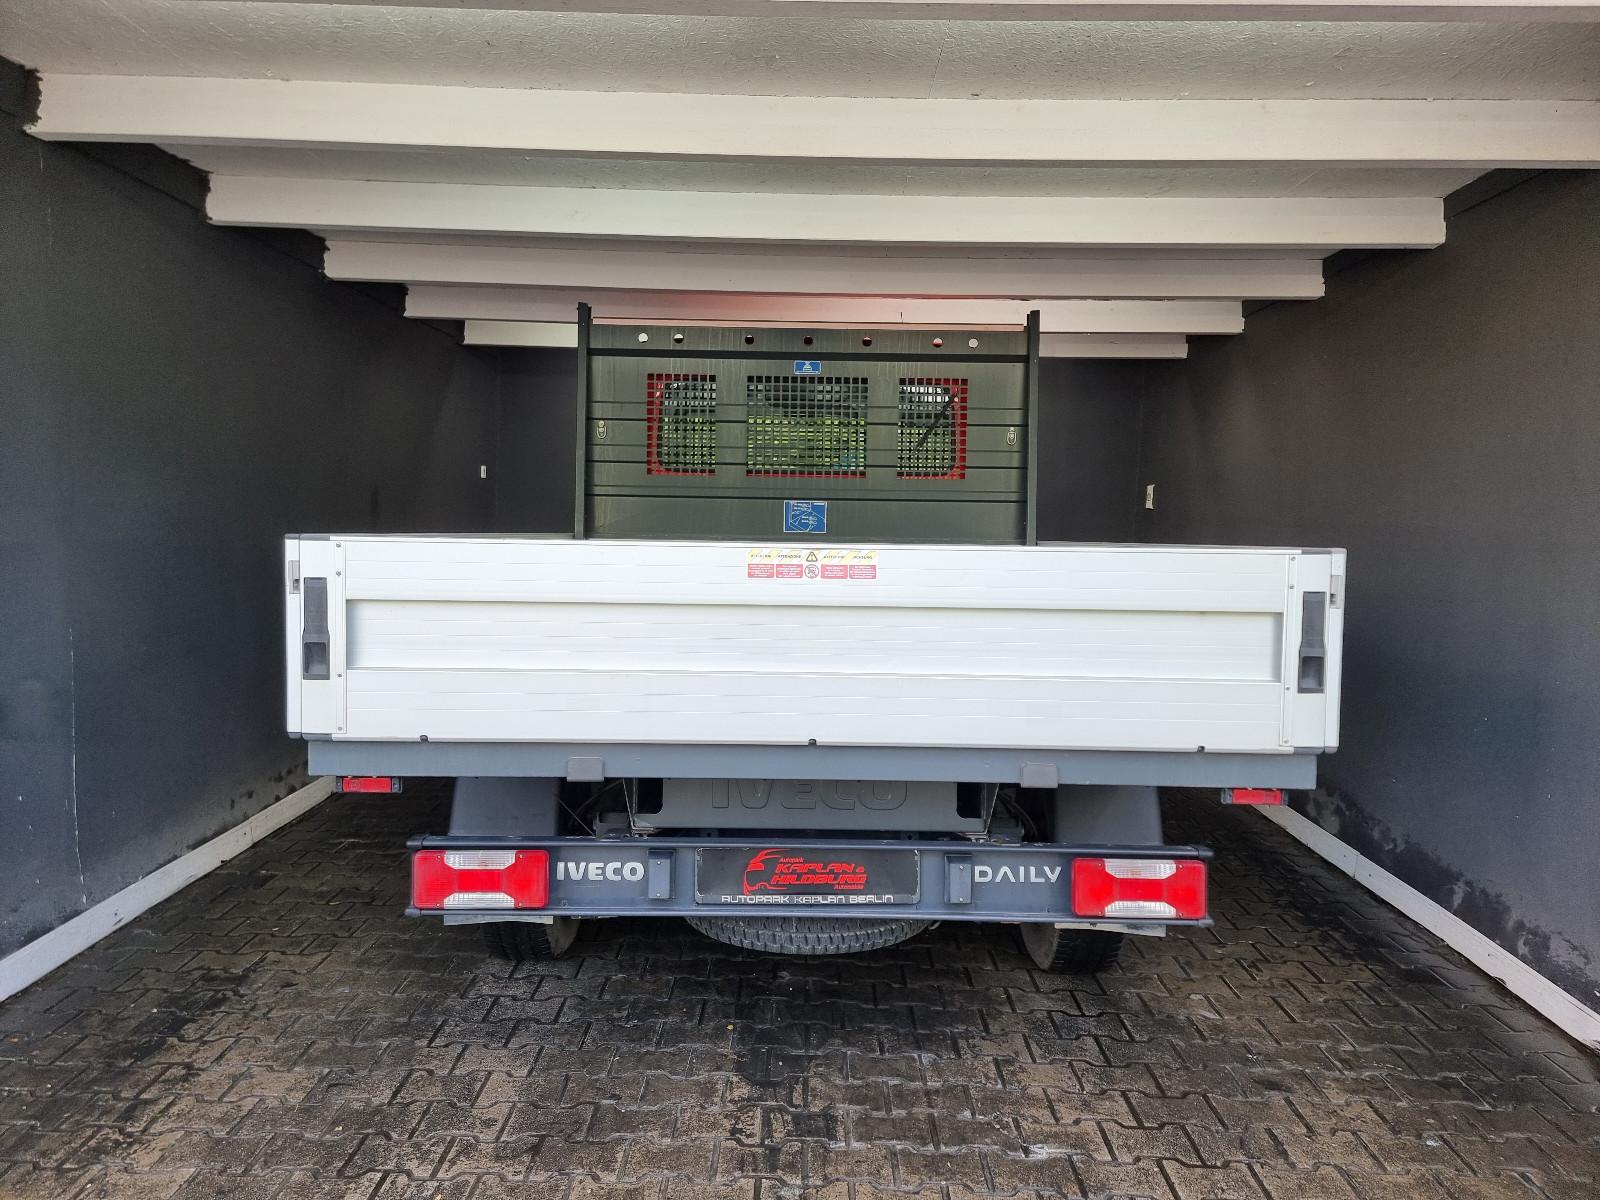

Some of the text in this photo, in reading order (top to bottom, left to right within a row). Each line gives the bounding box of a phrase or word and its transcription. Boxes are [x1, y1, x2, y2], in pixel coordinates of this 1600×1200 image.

[556, 861, 645, 881] IVECO
[775, 863, 856, 873] KAPLAN
[770, 874, 867, 884] HILDBURG
[974, 865, 1062, 883] DAILY
[721, 895, 894, 904] AUTOPARK KAPLAN BERLIN
